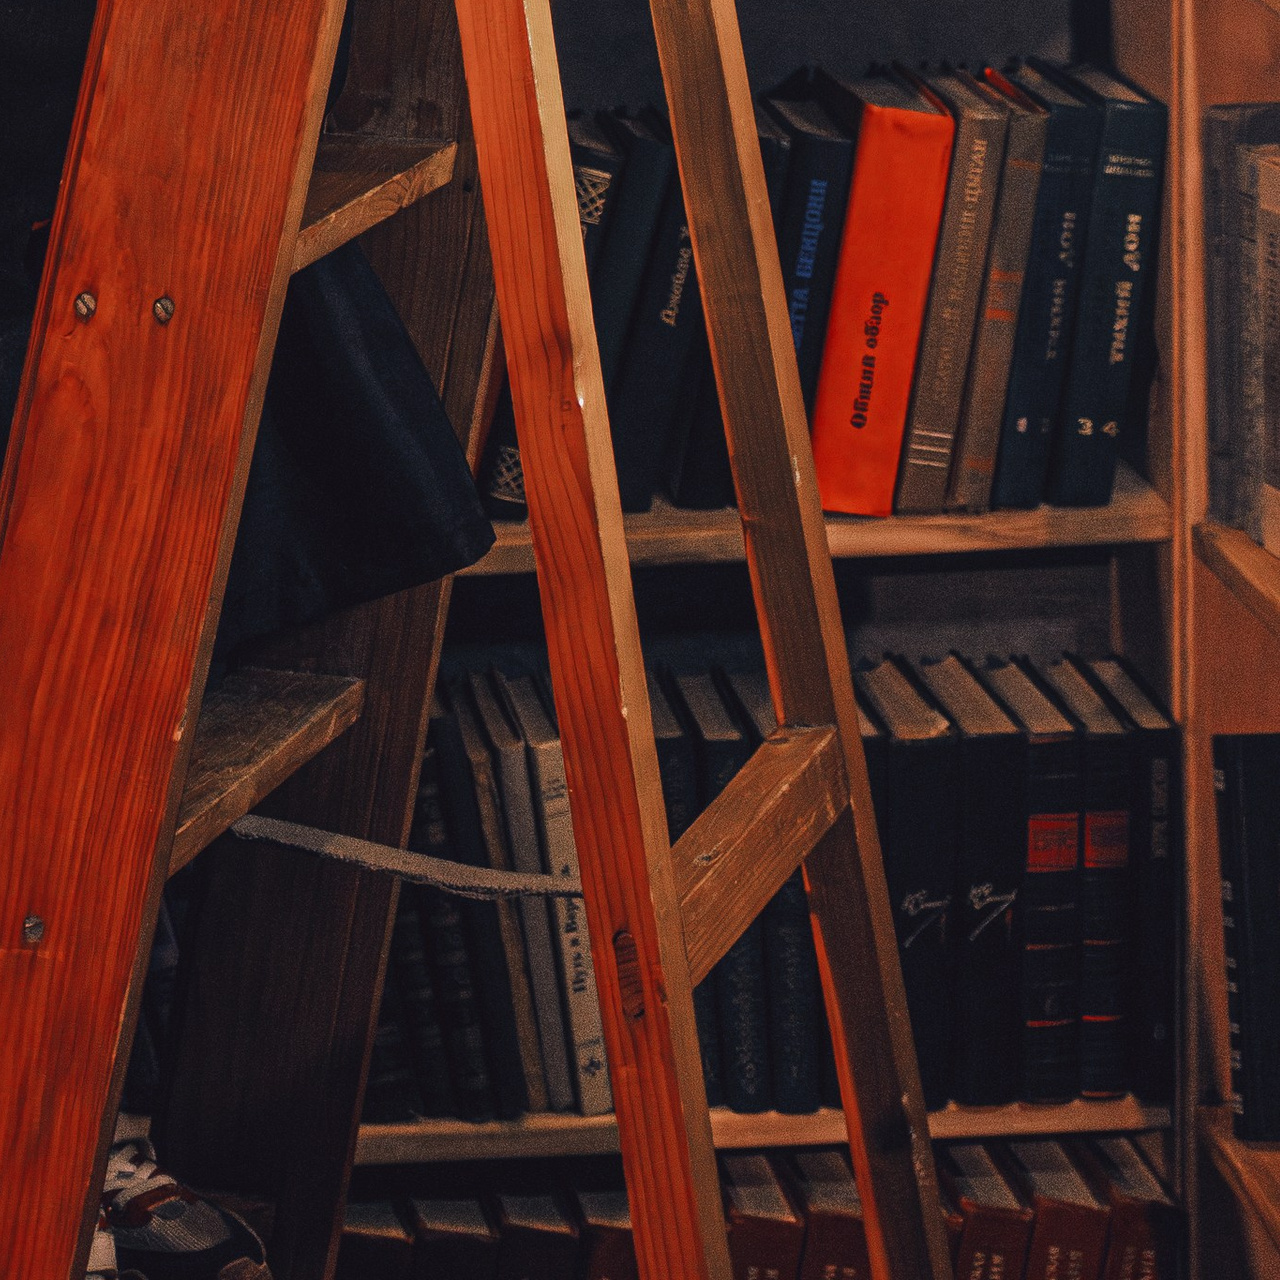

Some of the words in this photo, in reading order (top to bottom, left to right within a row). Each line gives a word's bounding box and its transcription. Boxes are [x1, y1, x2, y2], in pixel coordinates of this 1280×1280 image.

[966, 138, 989, 205] ЦЫГАН
[796, 179, 830, 279] БЕНЦОНИ
[1111, 281, 1133, 365] ТИХИЙ
[1122, 213, 1143, 271] ДОН
[849, 354, 876, 430] Общий
[865, 292, 886, 351] обзор
[1076, 417, 1094, 437] 3
